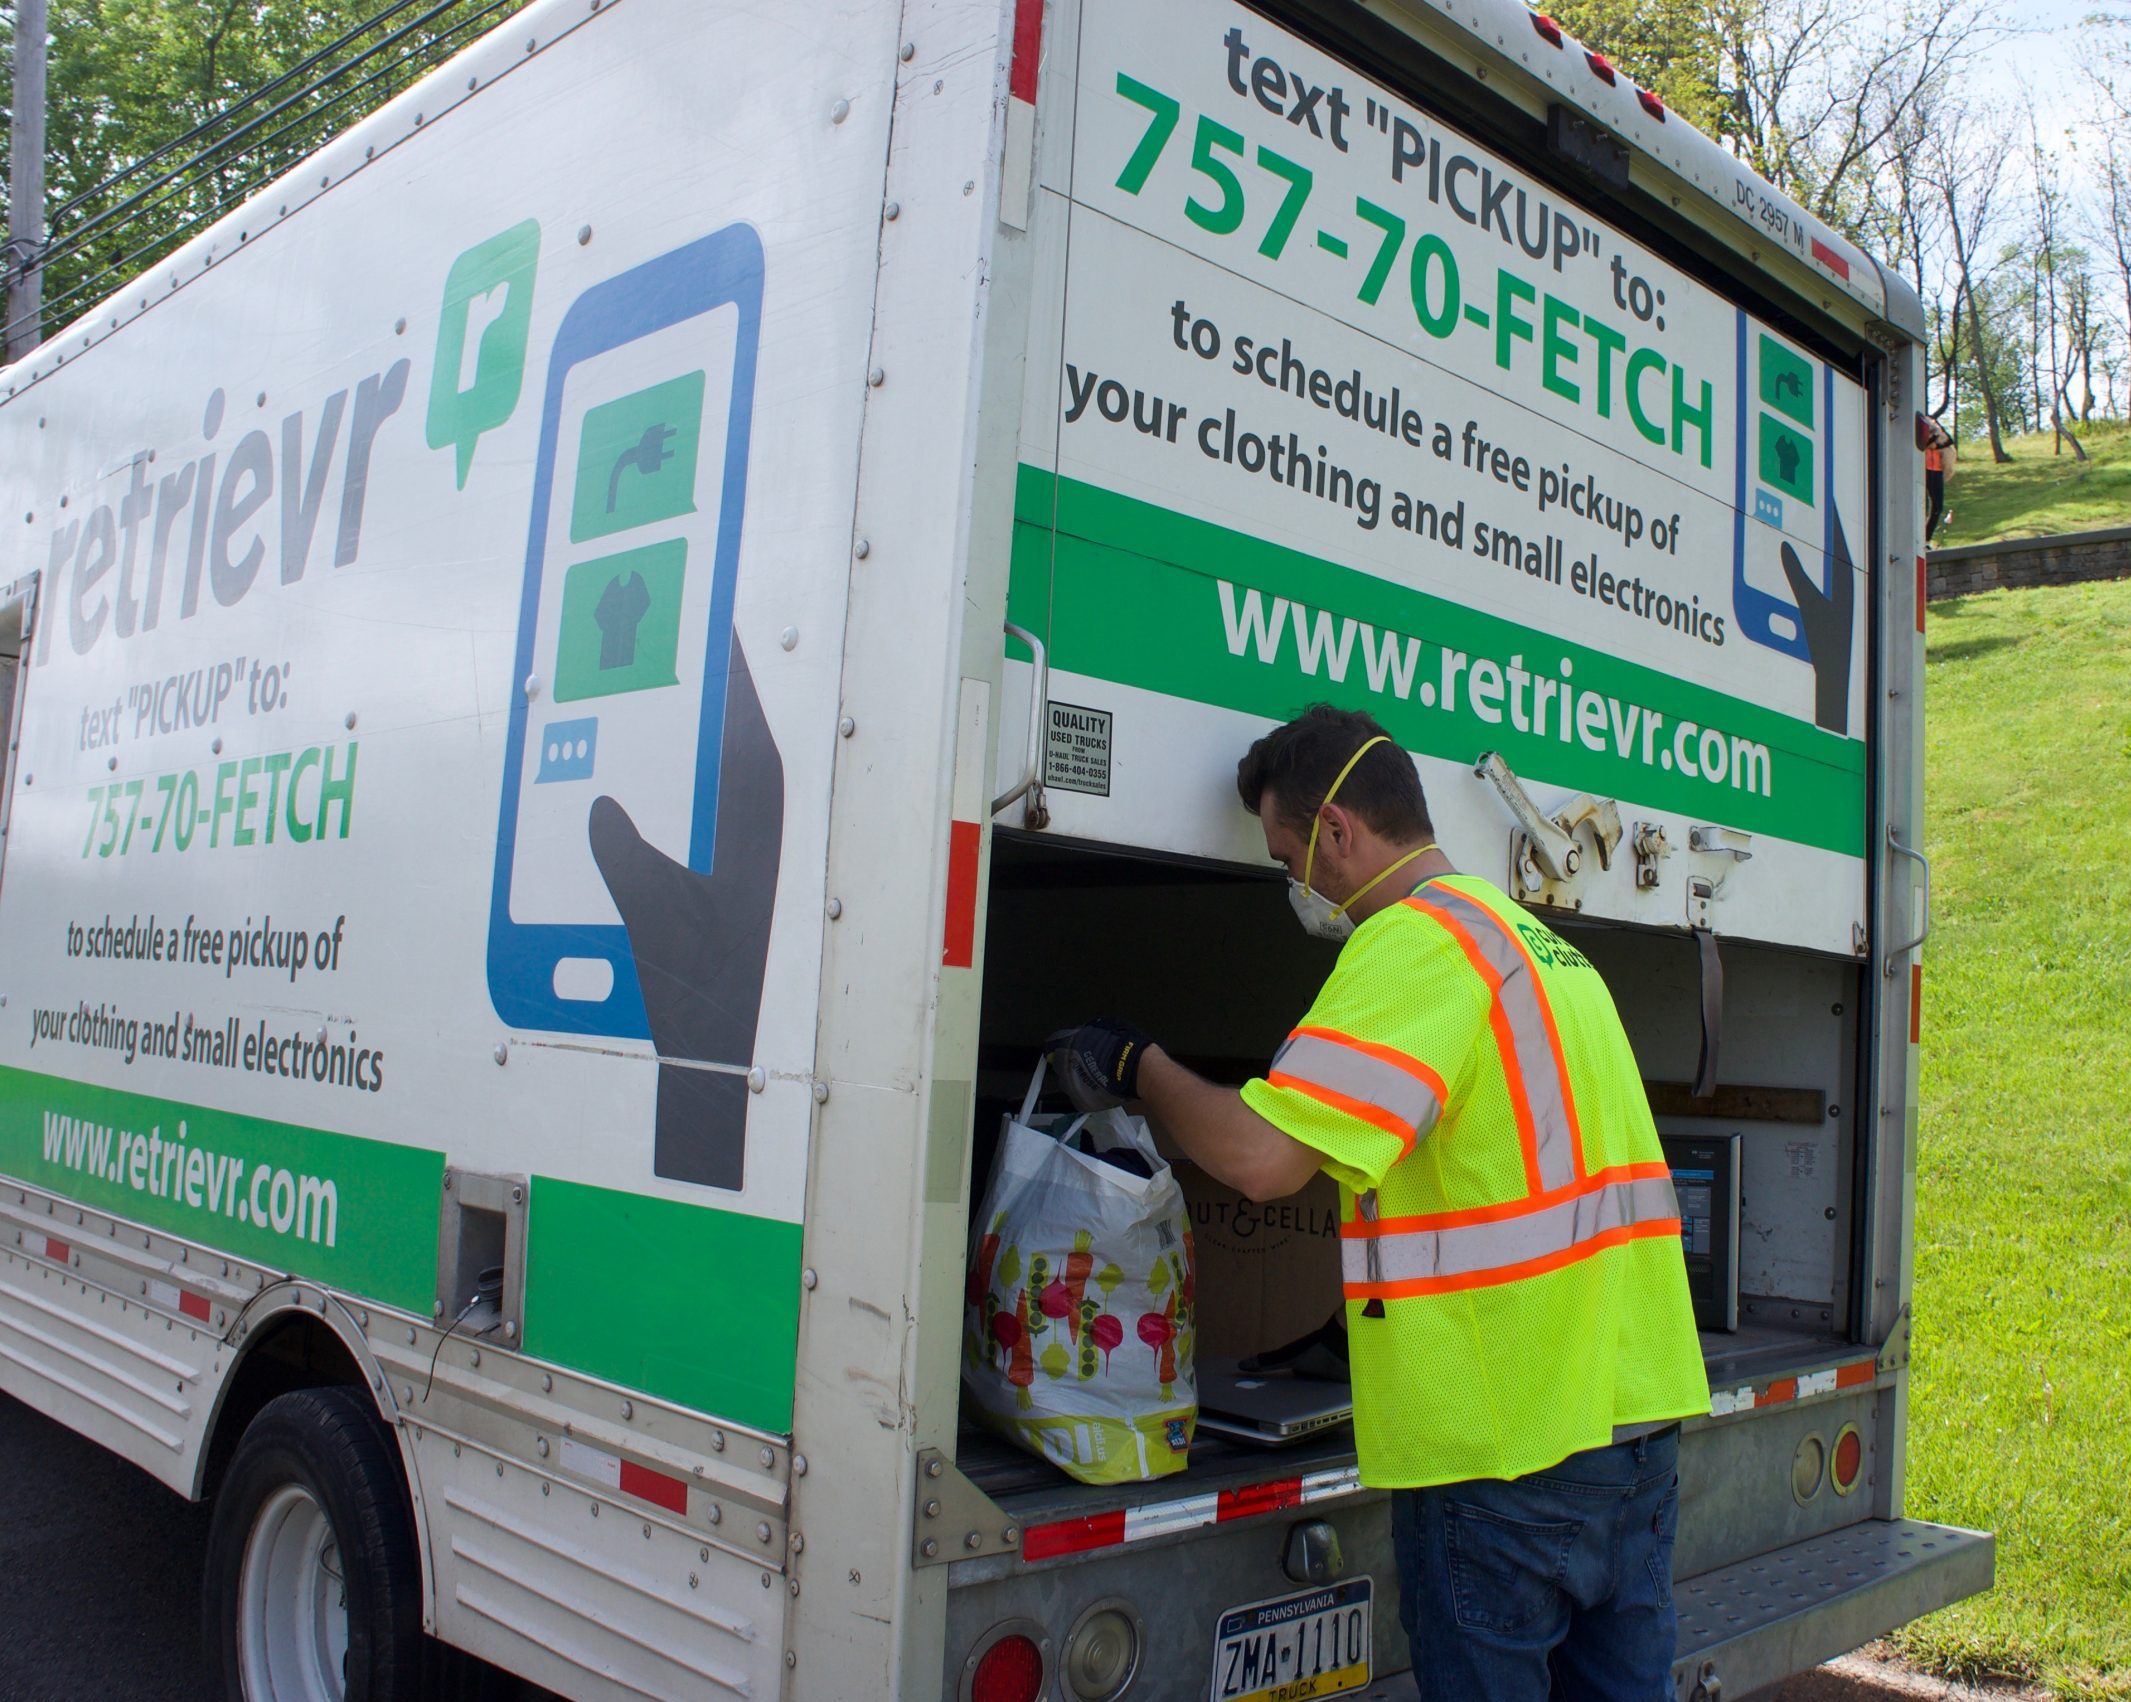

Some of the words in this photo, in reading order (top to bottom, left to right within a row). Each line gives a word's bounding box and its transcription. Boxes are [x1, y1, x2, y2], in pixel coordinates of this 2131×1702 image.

[1223, 27, 1350, 153] text
[1367, 97, 1600, 273] "PICKUP"
[1611, 254, 1666, 332] to:
[1736, 179, 1754, 213] DC
[1760, 197, 1789, 237] 2957
[1793, 221, 1804, 250] M
[1115, 71, 1712, 470] 757-70-FETCH
[1171, 300, 1221, 360] to
[1232, 336, 1423, 448] schedule
[1432, 421, 1452, 461] a
[1462, 420, 1531, 492] free
[1538, 463, 1644, 548] pickup
[1650, 513, 1680, 556] of
[36, 357, 411, 667] retrievr
[1065, 363, 1187, 444] your
[1197, 407, 1382, 531] clothing
[1391, 491, 1465, 550] and
[1473, 519, 1563, 586] small
[1570, 552, 1725, 647] electronics
[79, 696, 122, 751] text
[128, 656, 246, 739] "PICKUP"
[248, 658, 290, 715] to:
[1053, 710, 1106, 734] QUALITY
[1217, 579, 1771, 798] www.retrievr.com
[1048, 761, 1107, 779] 1-866-404-0355
[1050, 730, 1072, 745] USED
[1075, 734, 1107, 750] TRUCKS
[1071, 753, 1089, 764] TRUCK
[1090, 756, 1107, 767] SALES
[81, 741, 359, 859] 757-70-FETCH
[1047, 774, 1106, 790] uhaul.com/trucksales
[67, 920, 83, 957] to
[85, 914, 164, 961] schedule
[167, 929, 177, 962] a
[183, 914, 223, 965] free
[226, 915, 308, 983] pickup
[314, 914, 345, 971] of
[30, 1006, 67, 1049] your
[68, 1000, 139, 1065] clothing
[140, 1011, 180, 1058] and
[181, 1017, 240, 1068] small
[243, 1019, 384, 1092] electronics
[44, 1111, 338, 1248] www.retrievr.com
[1188, 1202, 1230, 1225] UT
[1258, 1593, 1335, 1624] PENNSYLVANIA
[1269, 1679, 1317, 1702] TRUCK
